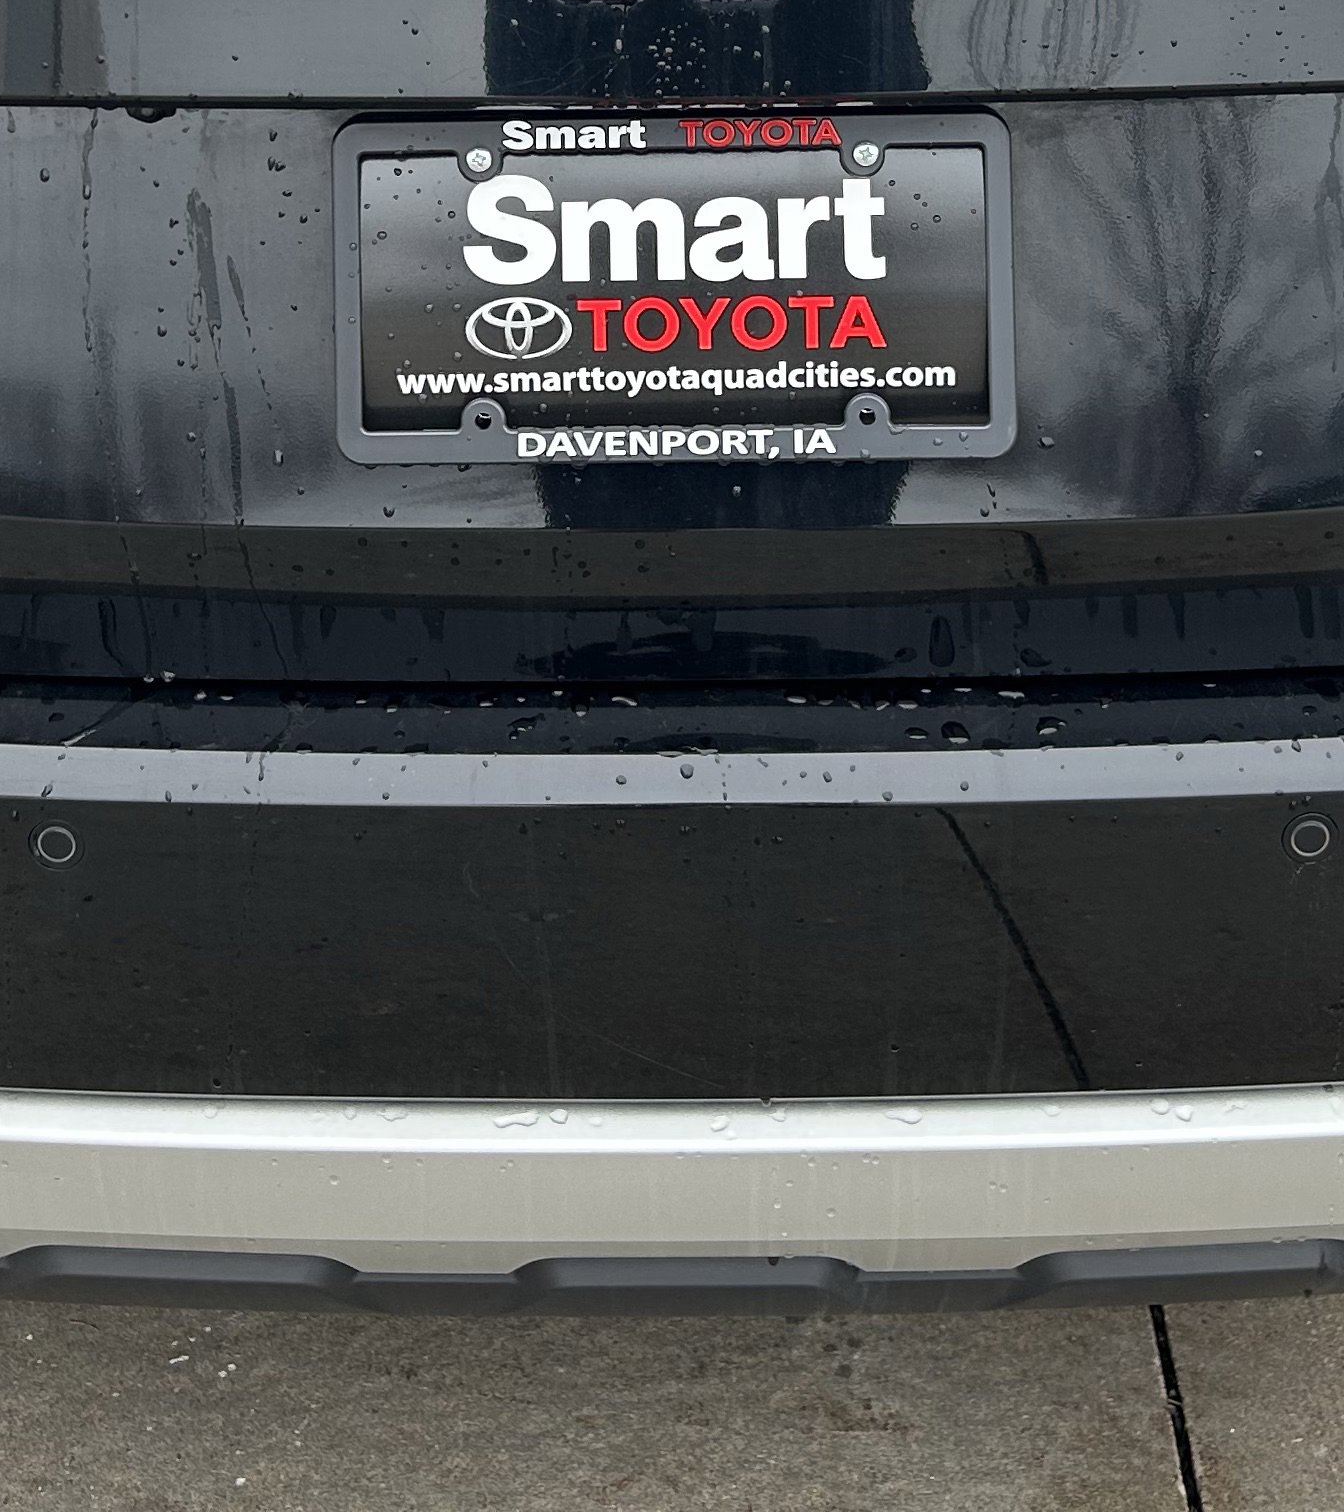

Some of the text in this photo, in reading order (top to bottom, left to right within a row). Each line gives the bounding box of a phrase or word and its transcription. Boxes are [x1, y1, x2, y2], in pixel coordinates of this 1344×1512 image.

[502, 119, 841, 150] Smart TOYOTA
[463, 175, 887, 285] Smart
[576, 294, 887, 352] TOYOTA
[397, 360, 956, 397] www.smarttoyotaquadcities.com
[516, 427, 837, 459] DAVENPORT, IA
